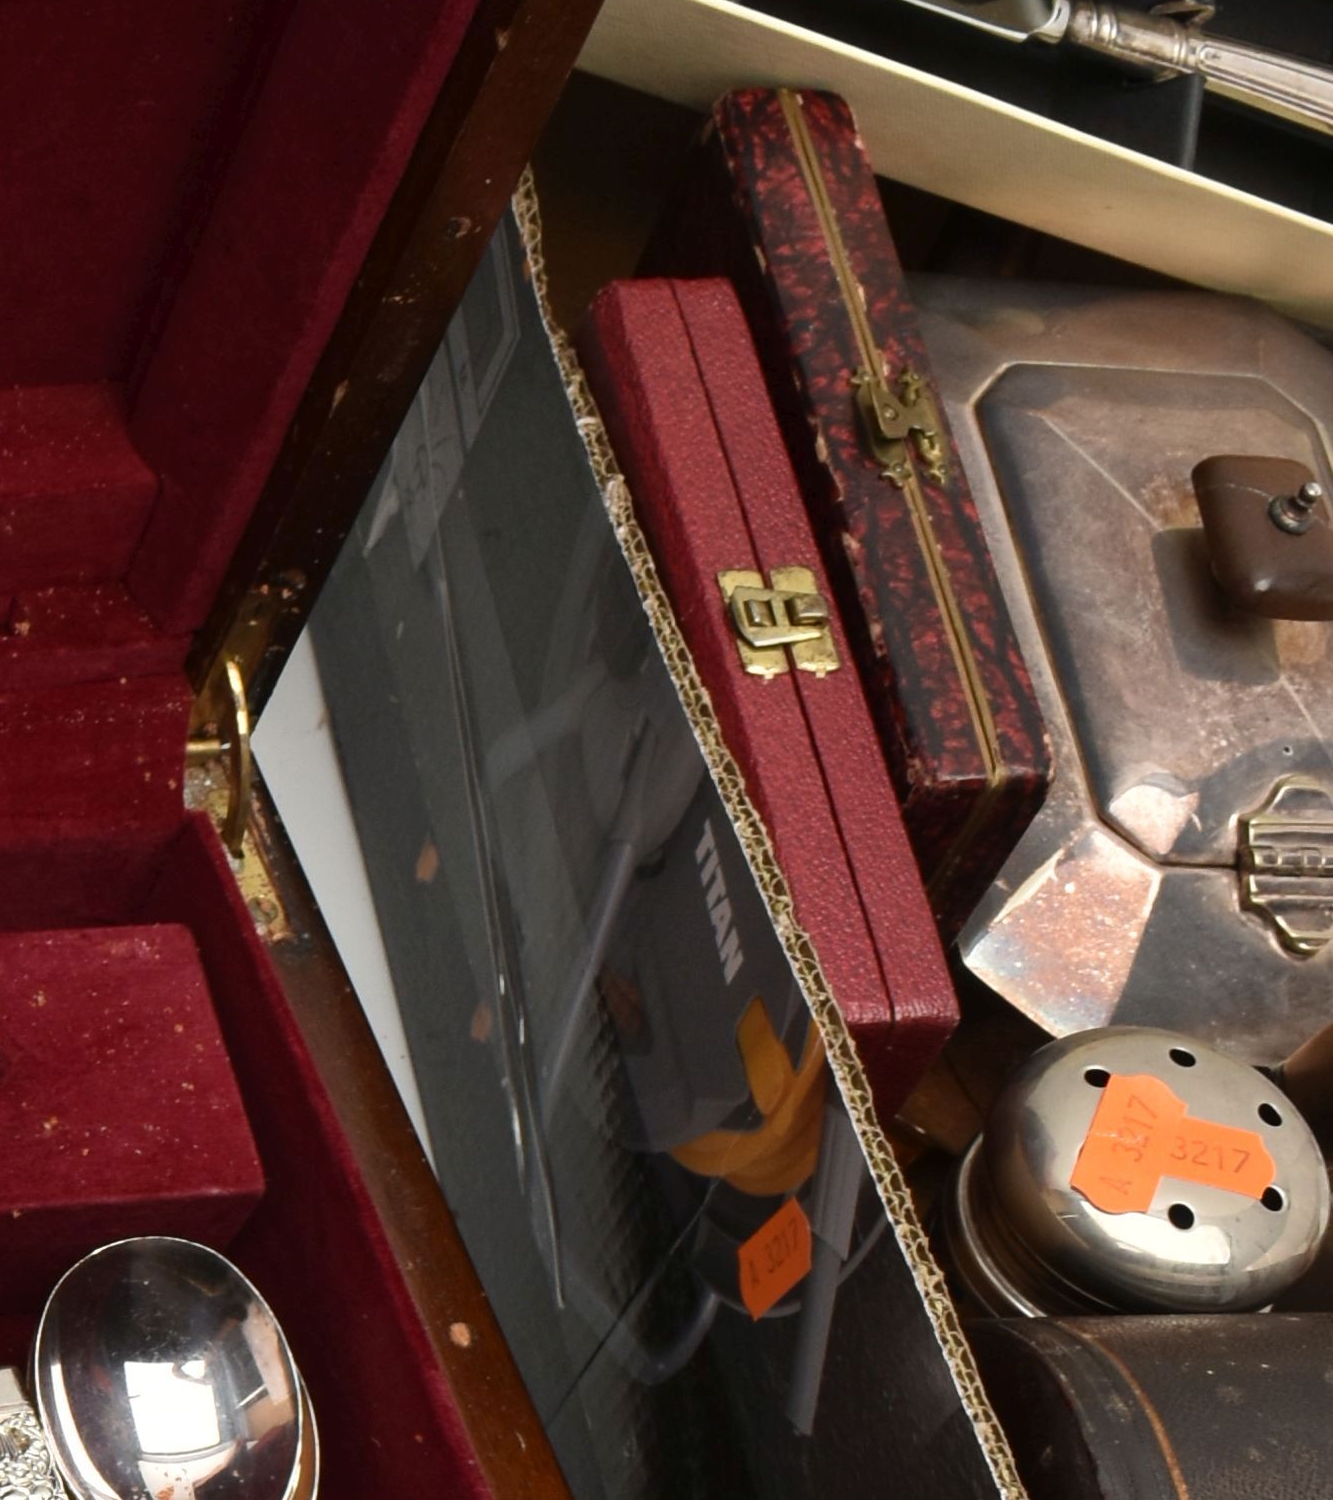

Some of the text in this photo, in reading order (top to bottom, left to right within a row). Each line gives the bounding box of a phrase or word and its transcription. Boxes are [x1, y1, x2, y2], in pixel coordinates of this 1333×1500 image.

[695, 818, 744, 986] TITAN
[1099, 1093, 1158, 1195] A 3217
[1170, 1135, 1251, 1174] 3217
